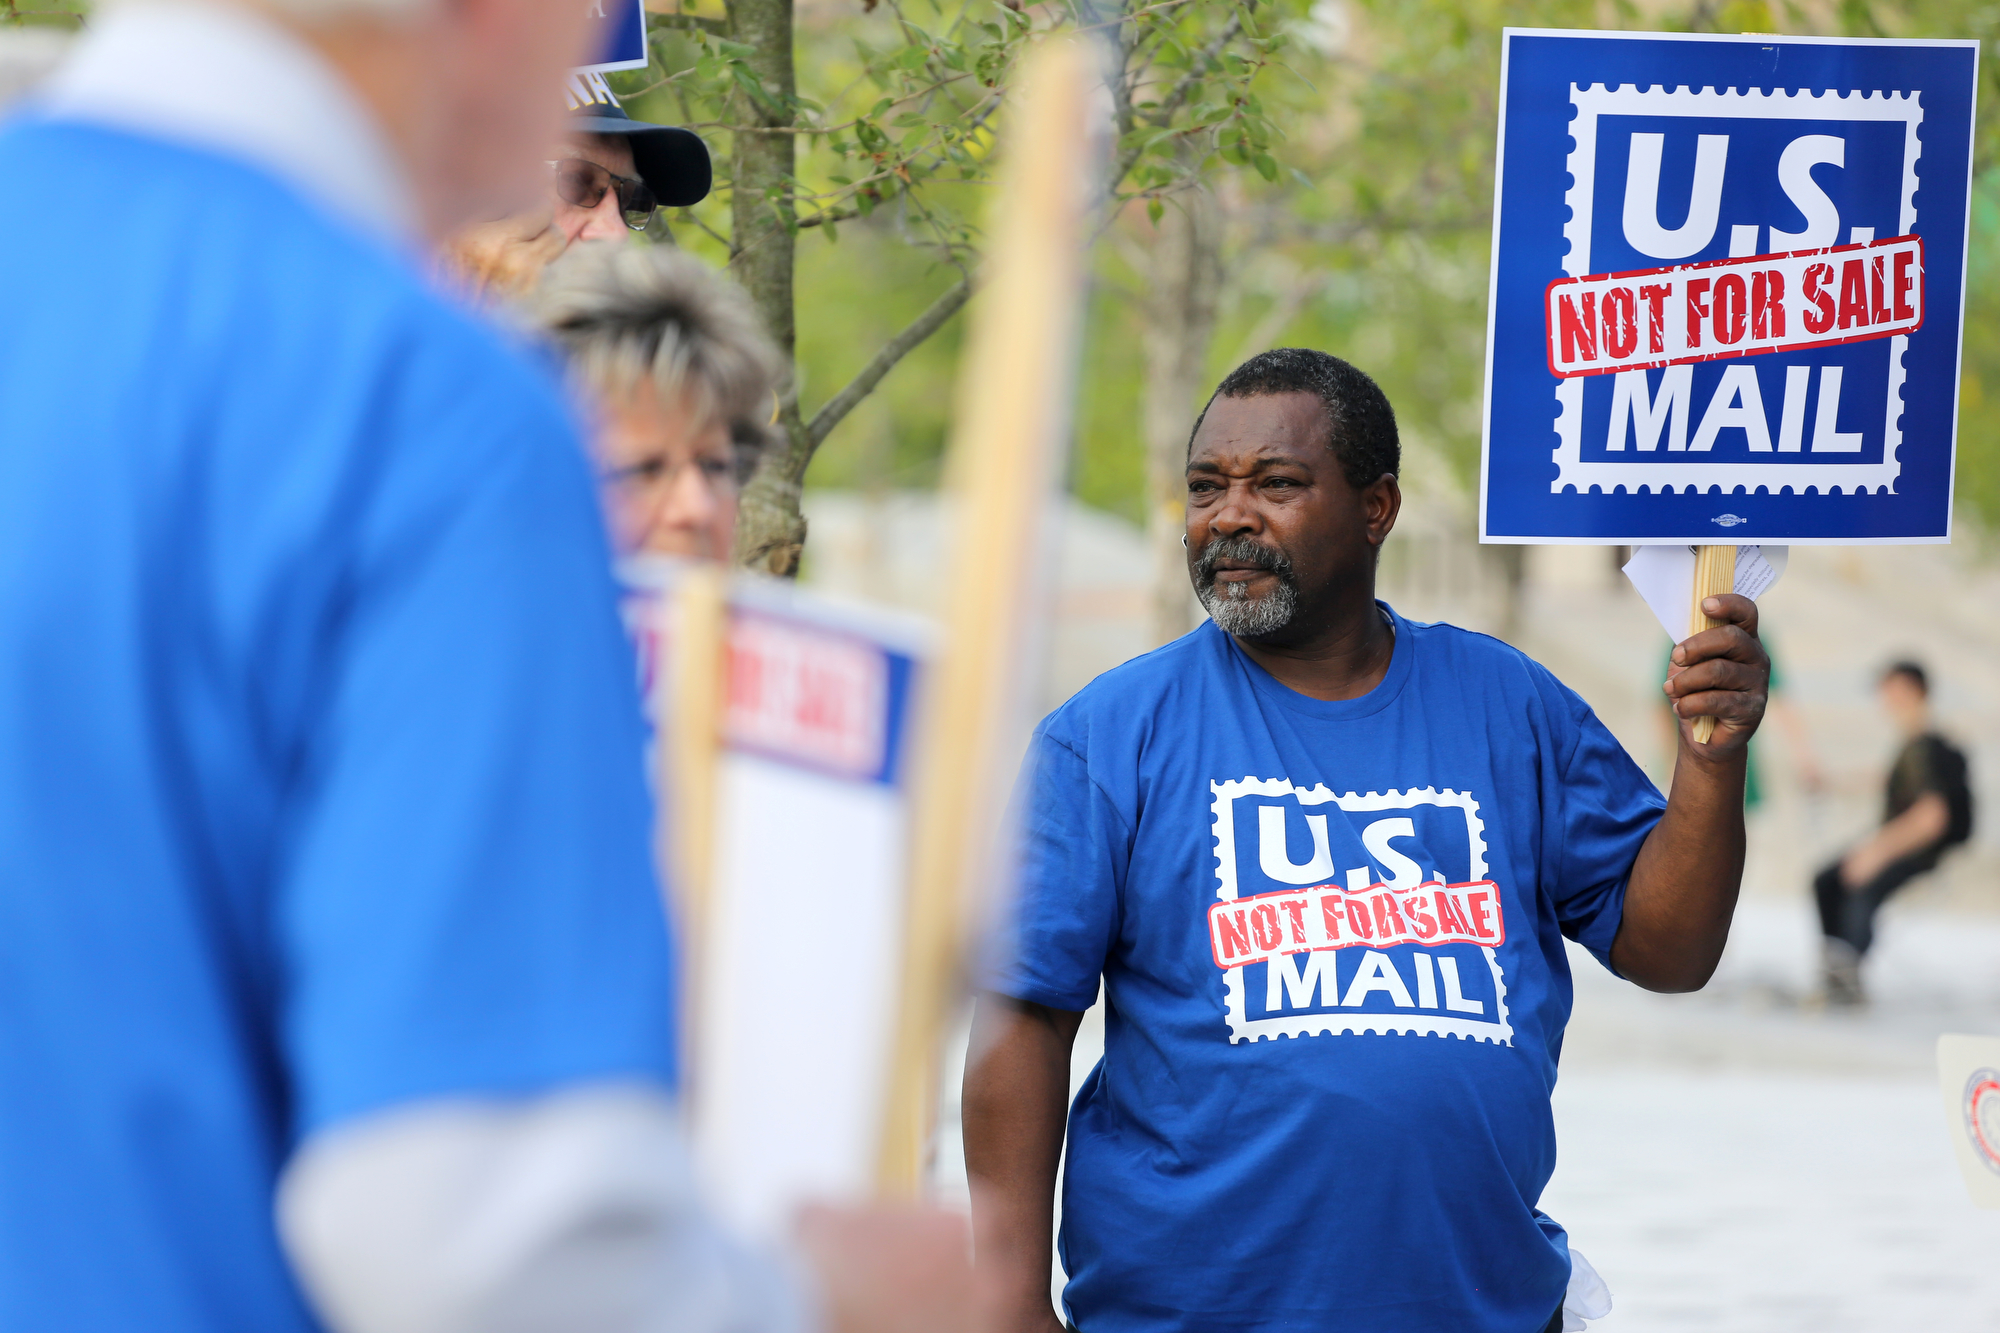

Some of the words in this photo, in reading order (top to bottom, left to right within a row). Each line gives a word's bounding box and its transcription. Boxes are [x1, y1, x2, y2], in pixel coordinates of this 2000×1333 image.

[1622, 132, 1875, 260] U.S.
[1558, 282, 1672, 363] NOT
[1686, 269, 1786, 348] FOR
[1801, 250, 1915, 333] SALE
[1605, 364, 1864, 453] MAIL
[1258, 805, 1447, 891] U.S.
[1216, 900, 1308, 959] NOT
[1320, 892, 1406, 942] FOR
[1403, 891, 1495, 940] SALE
[1265, 949, 1484, 1015] MAIL
